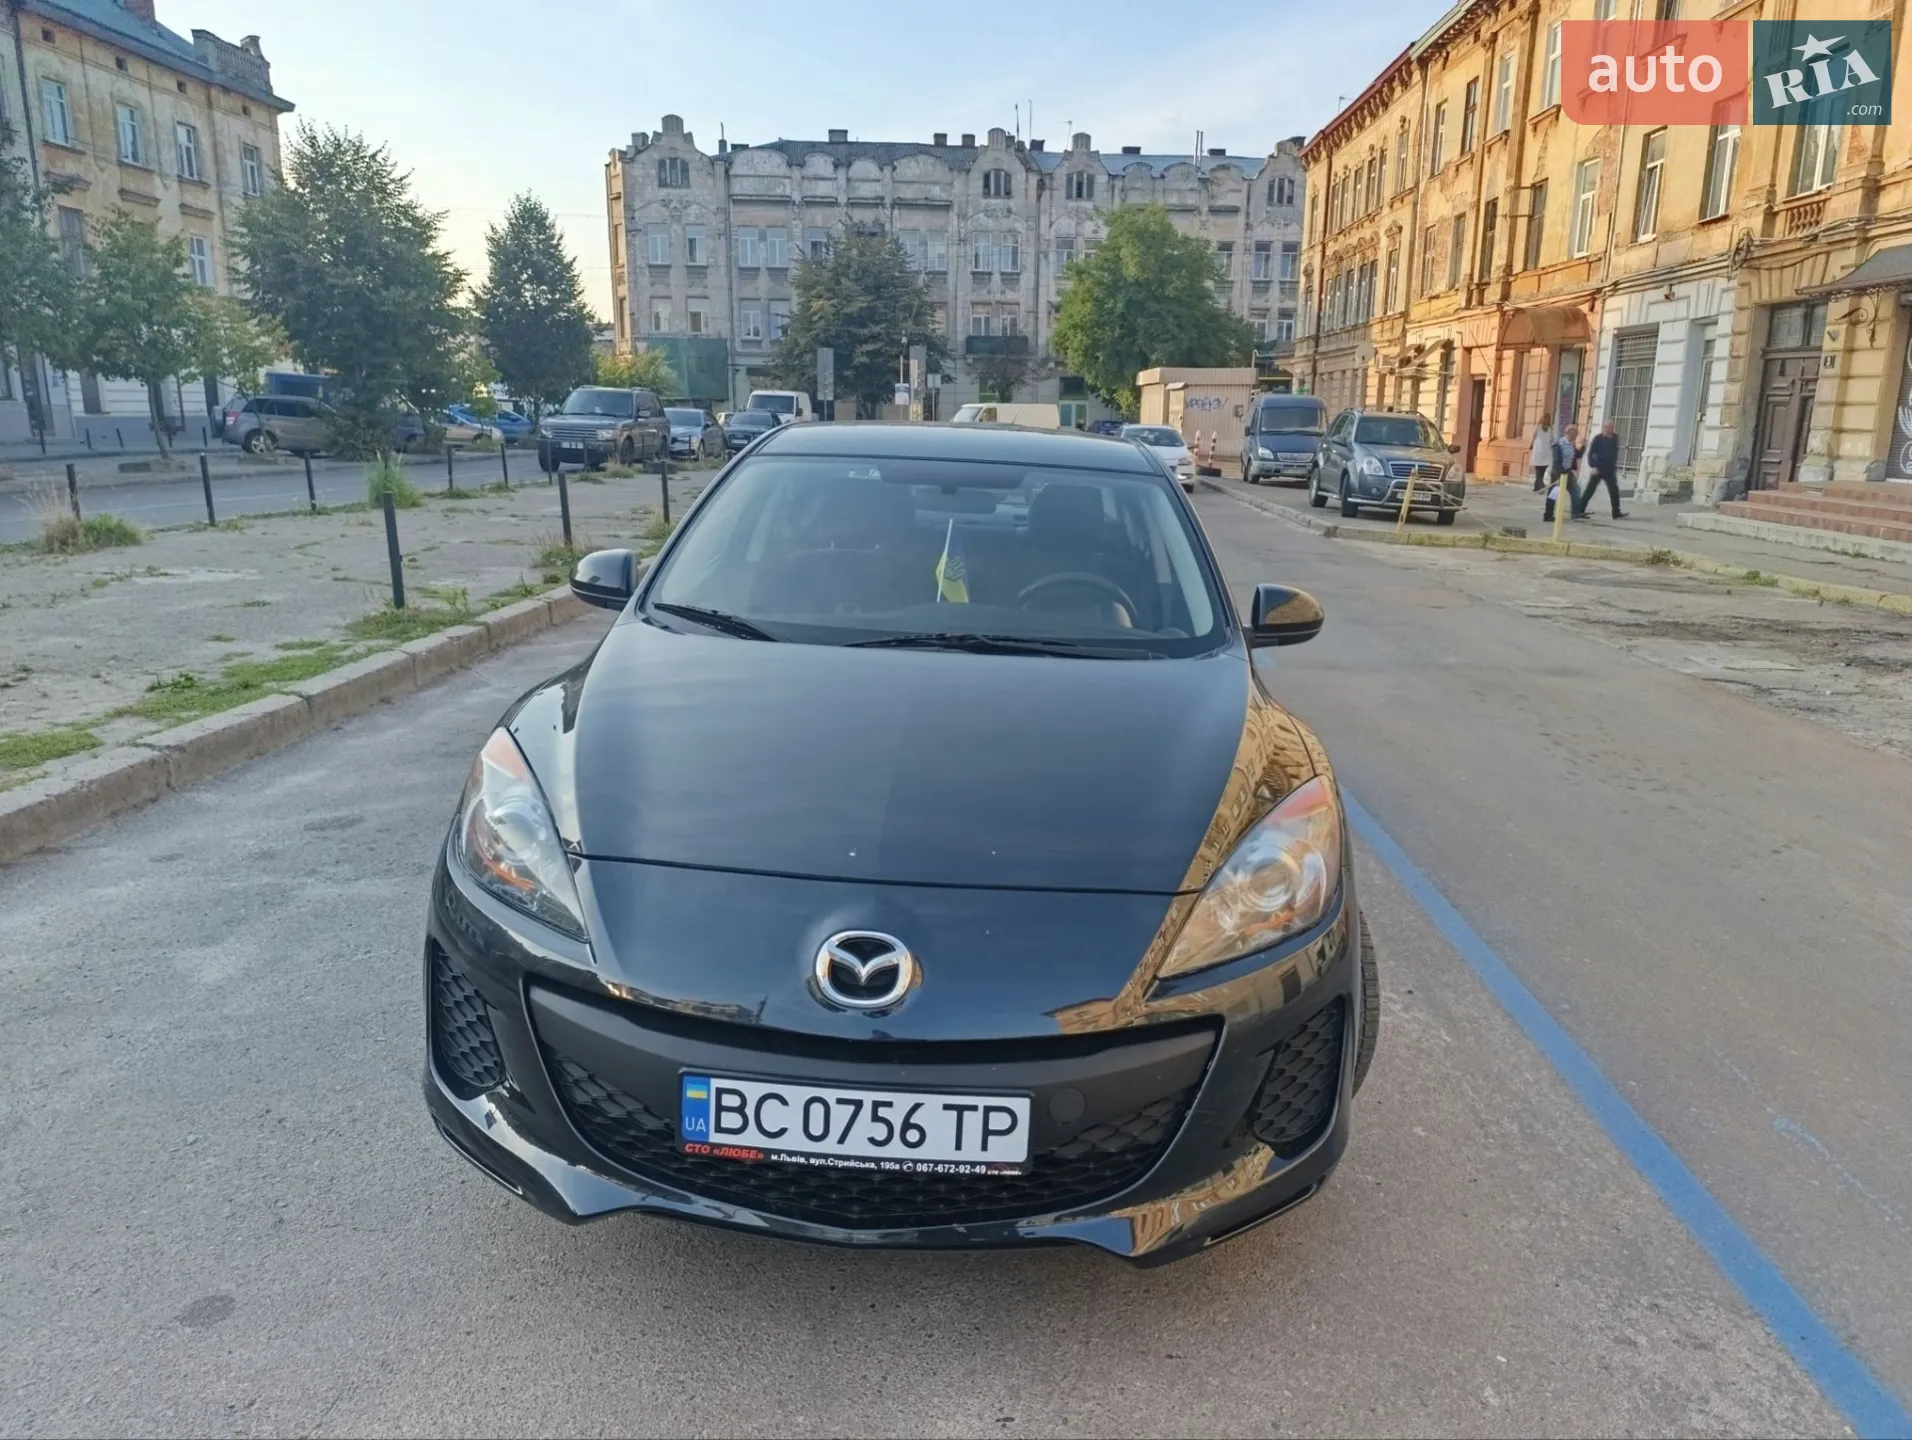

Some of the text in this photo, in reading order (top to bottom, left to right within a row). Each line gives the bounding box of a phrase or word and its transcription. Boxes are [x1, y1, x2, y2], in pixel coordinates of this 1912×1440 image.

[685, 1116, 707, 1133] UA
[714, 1086, 1018, 1152] BC 0756 TP
[684, 1143, 710, 1155] СТО
[915, 1162, 987, 1174] 067-672-92-49
